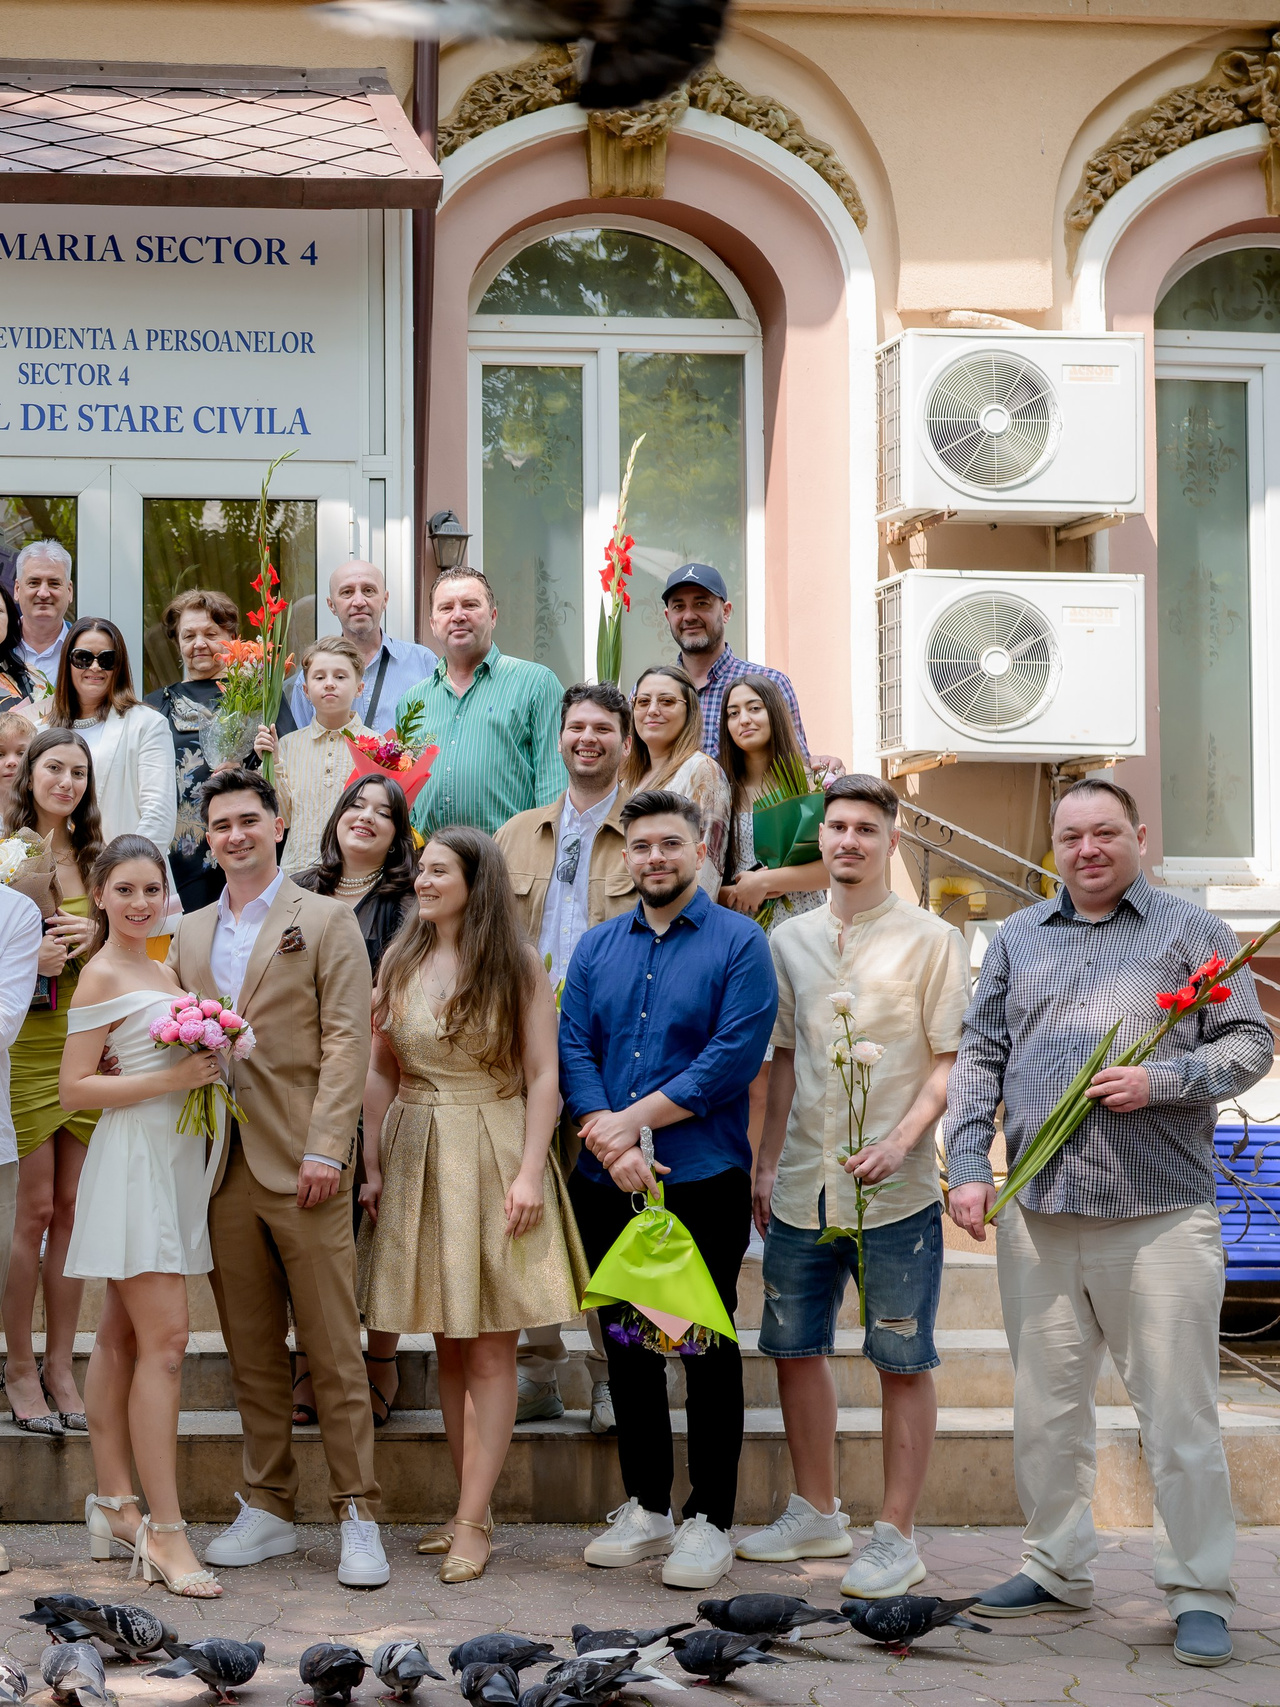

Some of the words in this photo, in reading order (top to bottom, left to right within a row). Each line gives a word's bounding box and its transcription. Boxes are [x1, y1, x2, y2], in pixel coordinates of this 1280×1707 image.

[135, 236, 290, 266] SECTOR
[299, 240, 319, 266] 4
[123, 328, 140, 351] A
[146, 328, 316, 354] PERSOANELOR
[17, 362, 112, 386] SECTOR
[118, 366, 130, 387] 4
[20, 403, 69, 431] DE
[78, 403, 184, 433] STARE
[193, 405, 312, 436] CIVILA
